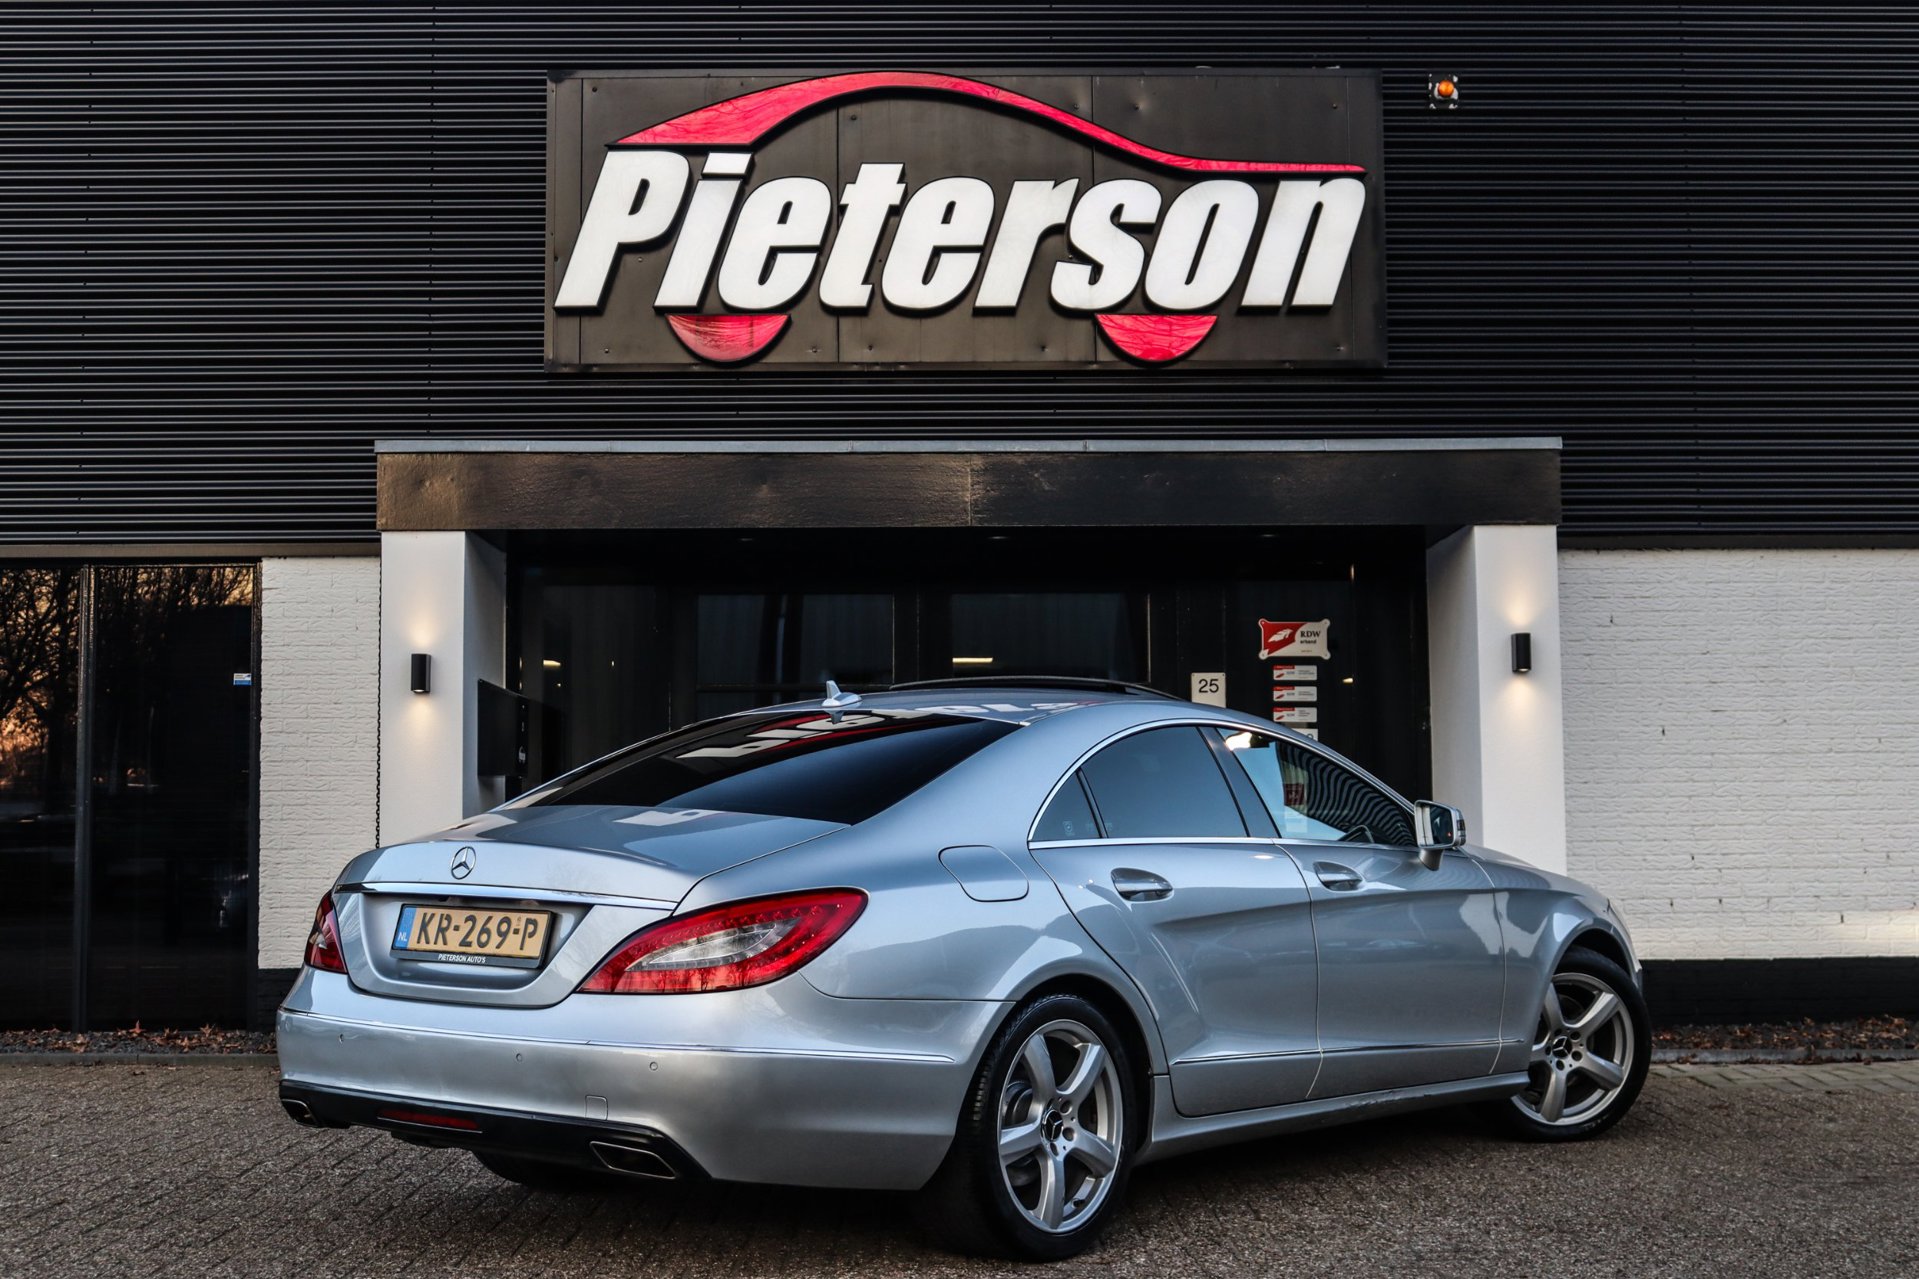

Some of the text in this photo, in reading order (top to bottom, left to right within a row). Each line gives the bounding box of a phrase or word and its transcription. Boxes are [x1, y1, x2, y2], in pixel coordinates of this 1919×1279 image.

[553, 150, 1367, 312] Pieterson
[1300, 630, 1321, 638] RDW
[1198, 679, 1219, 693] 25
[398, 932, 408, 942] NL
[416, 912, 538, 950] KR-269-P
[438, 953, 467, 962] PIETERSON
